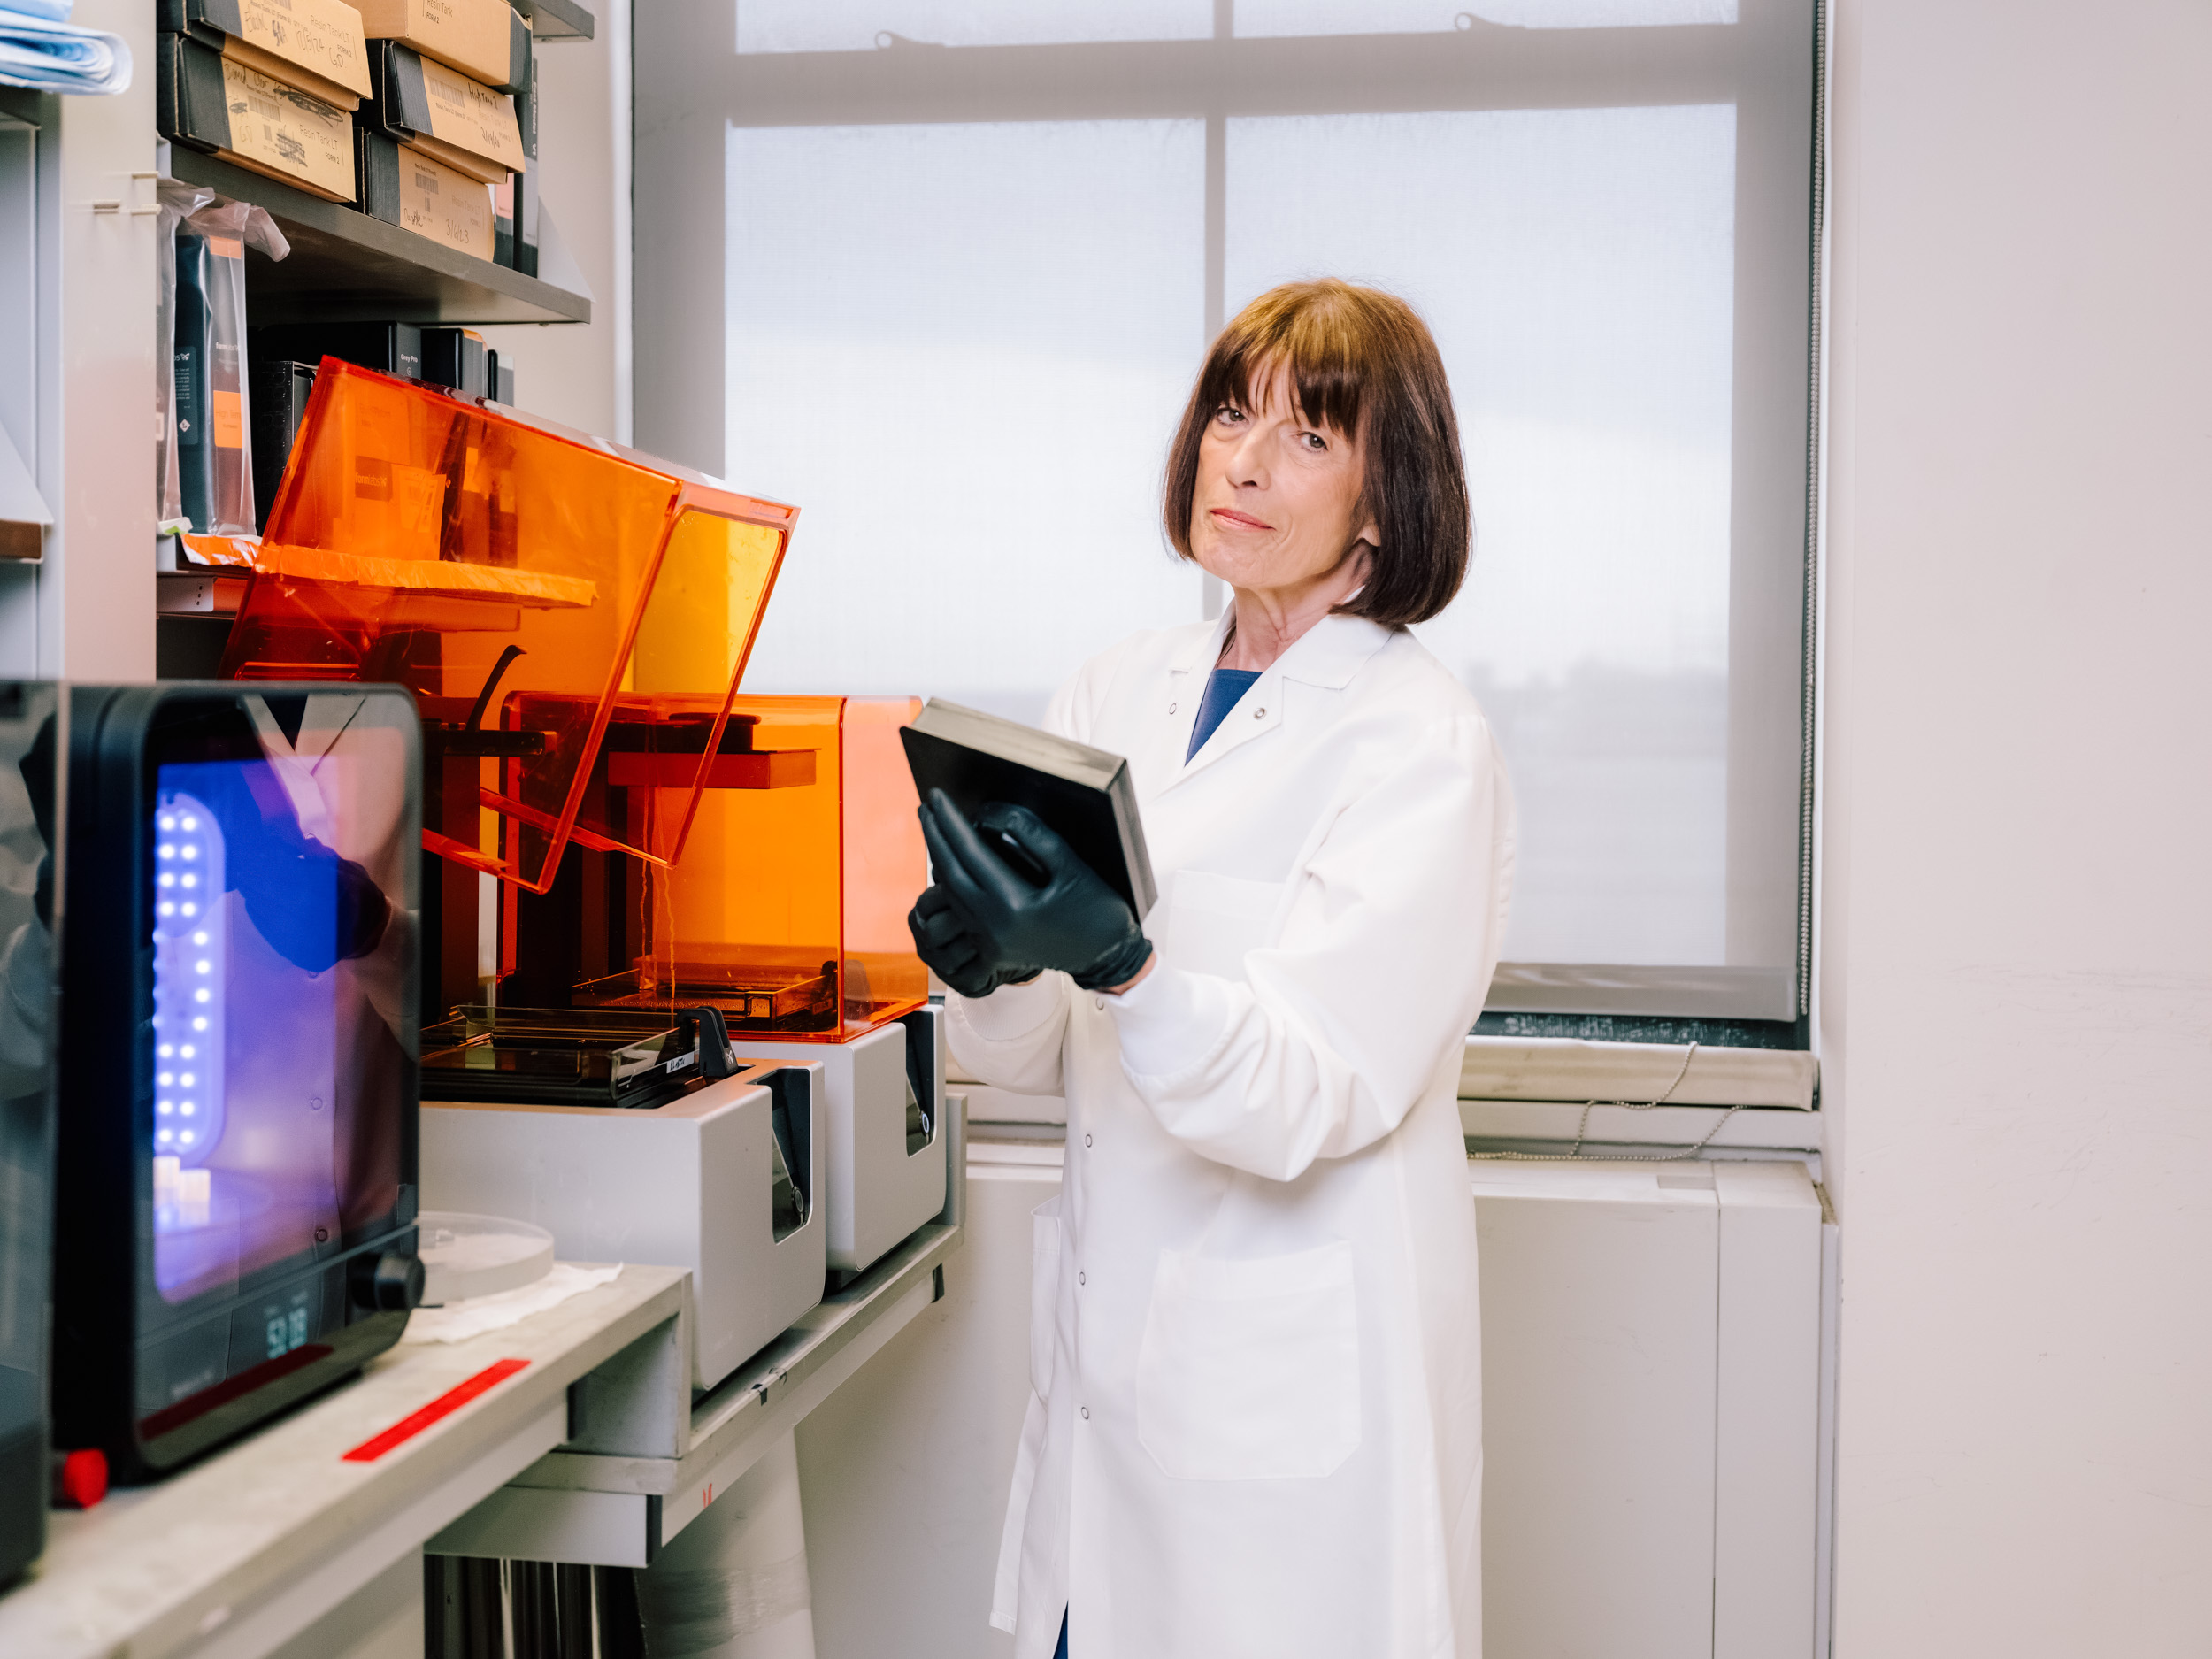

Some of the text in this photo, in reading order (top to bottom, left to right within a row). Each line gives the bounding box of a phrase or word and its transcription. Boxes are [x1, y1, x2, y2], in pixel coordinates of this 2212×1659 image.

[426, 0, 453, 18] Resin Tank
[426, 12, 436, 22] FORM
[310, 14, 327, 33] Resin
[327, 23, 342, 38] Tank
[342, 31, 350, 42] LT
[336, 44, 349, 56] FORM
[299, 124, 338, 150] Resin Tank LT
[325, 151, 336, 163] FORM
[400, 353, 411, 363] Grey
[355, 472, 380, 487] formlabs
